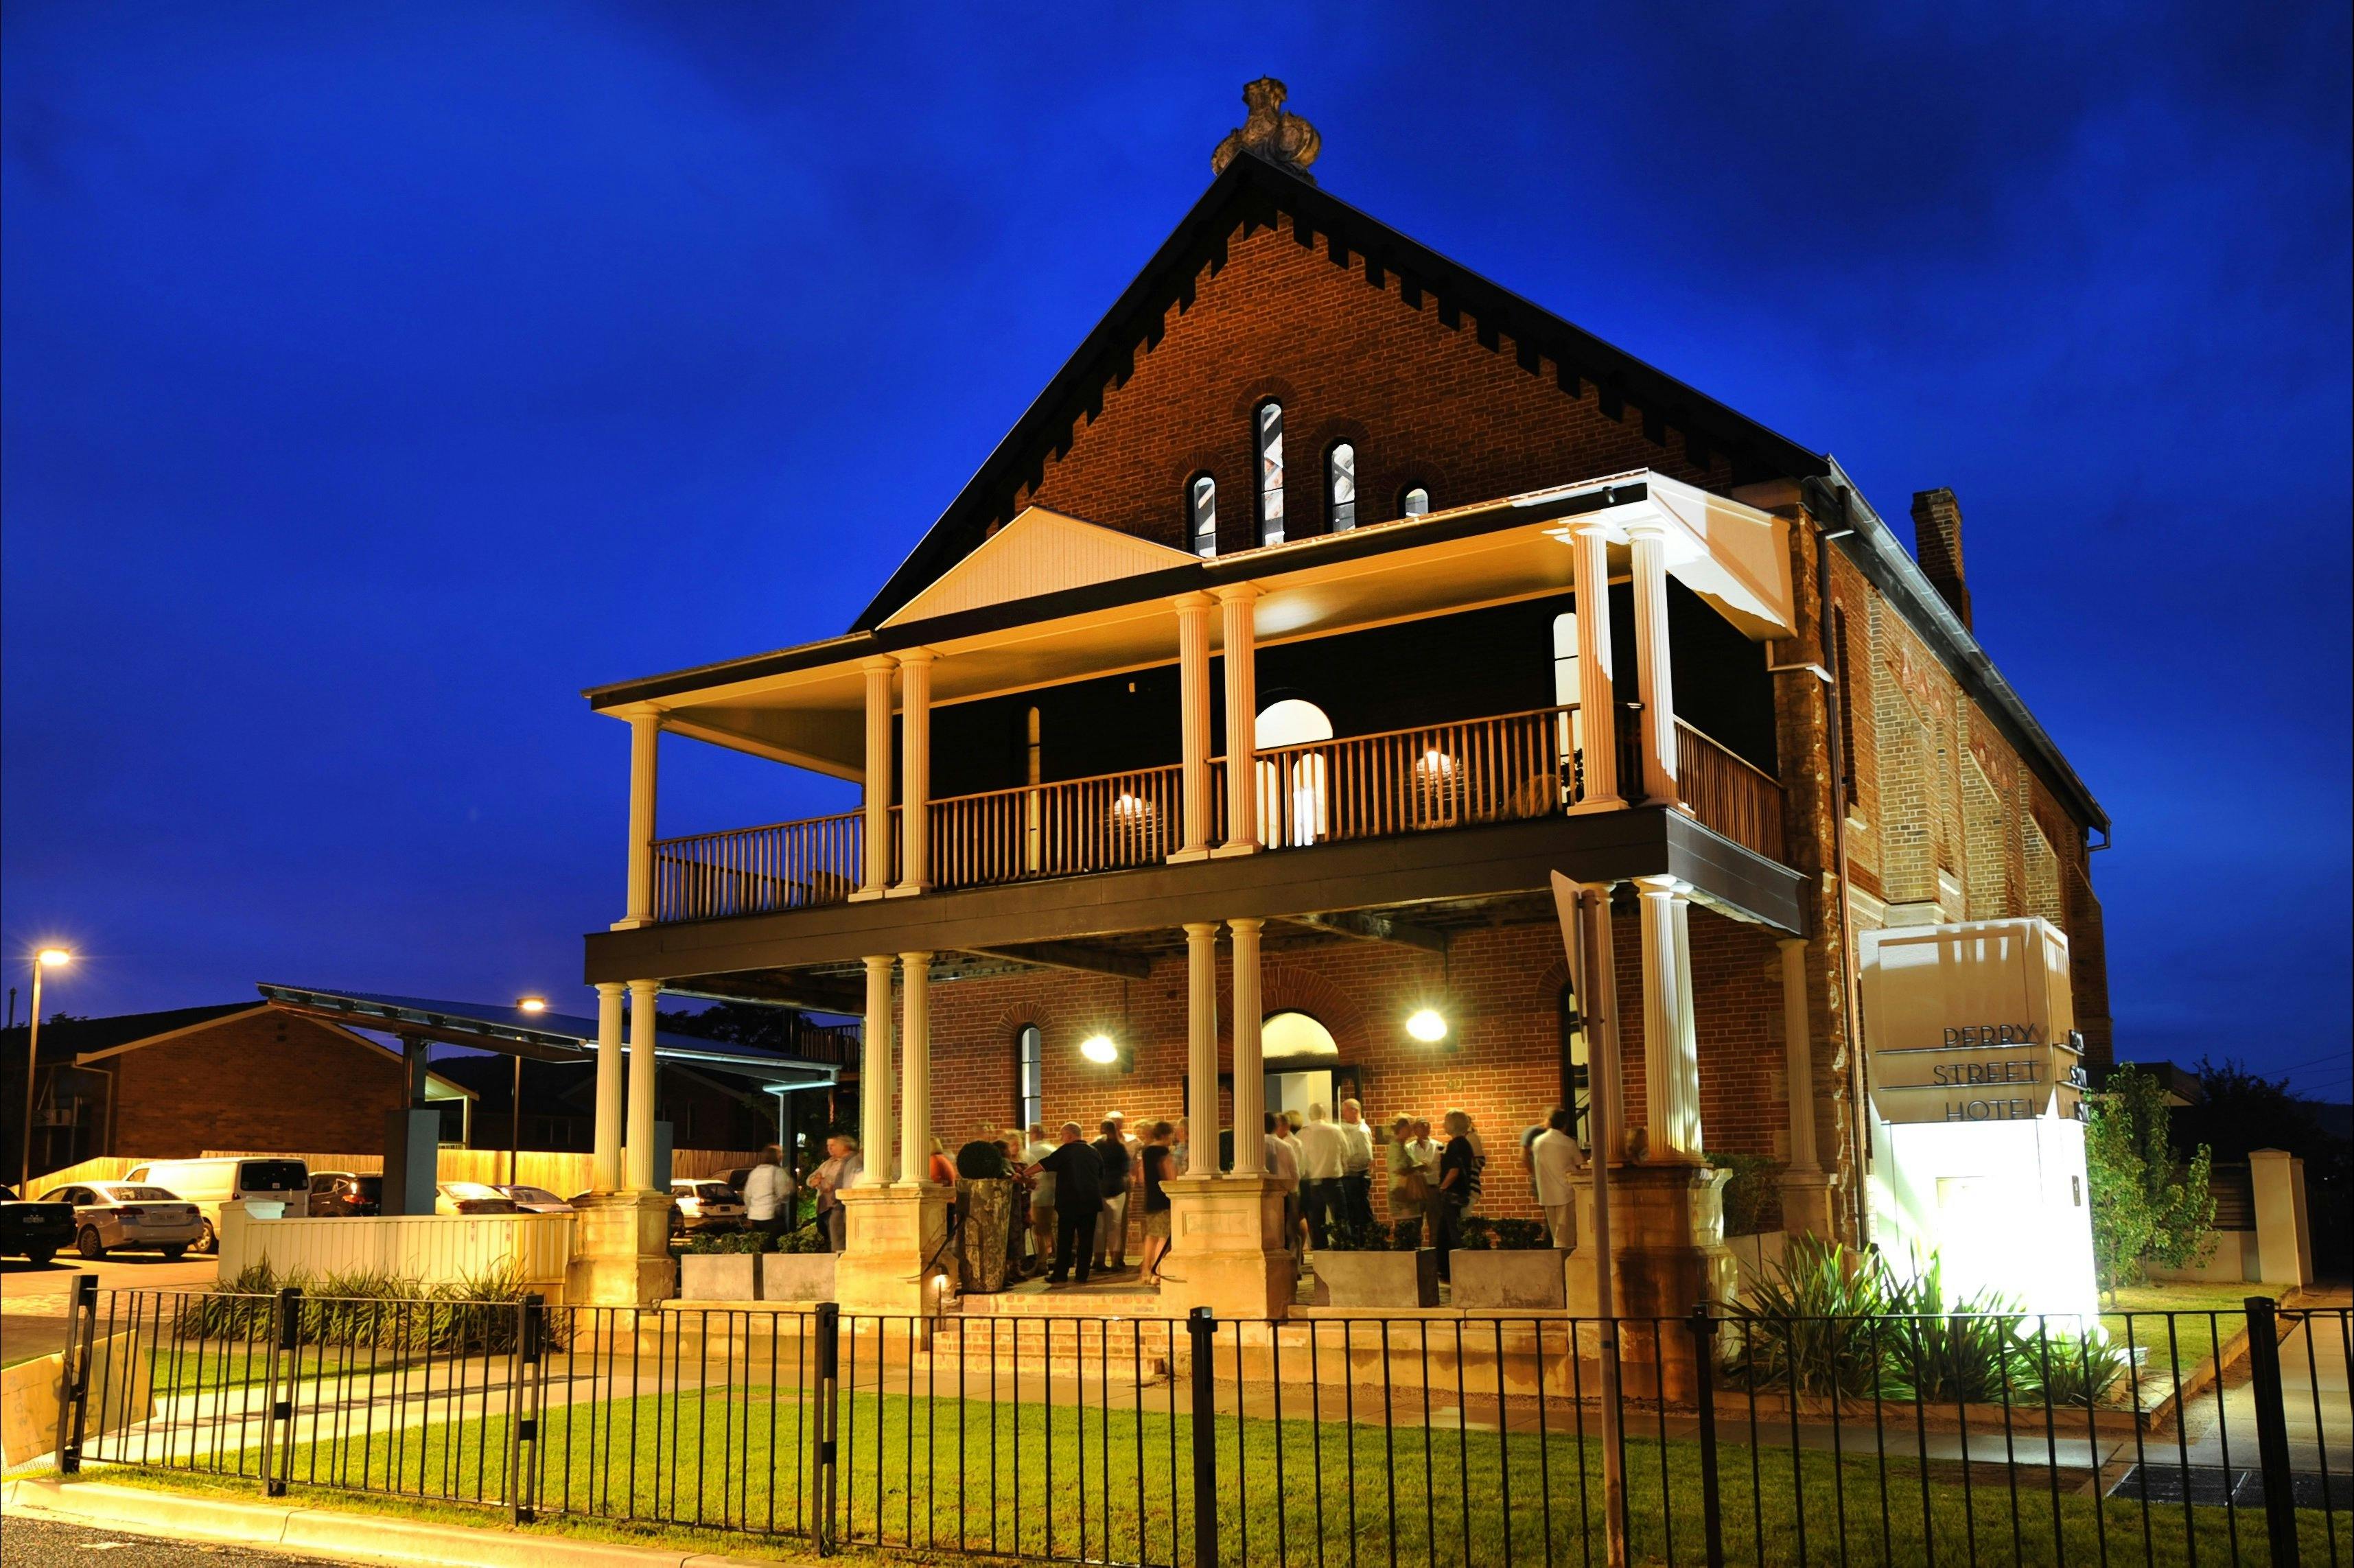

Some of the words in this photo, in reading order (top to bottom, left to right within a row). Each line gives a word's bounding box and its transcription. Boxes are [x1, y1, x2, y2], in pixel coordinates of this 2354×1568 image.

[1944, 1023, 2034, 1048] PERRY
[1934, 1061, 2039, 1086] STREET
[1946, 1099, 2039, 1122] HOTEL
